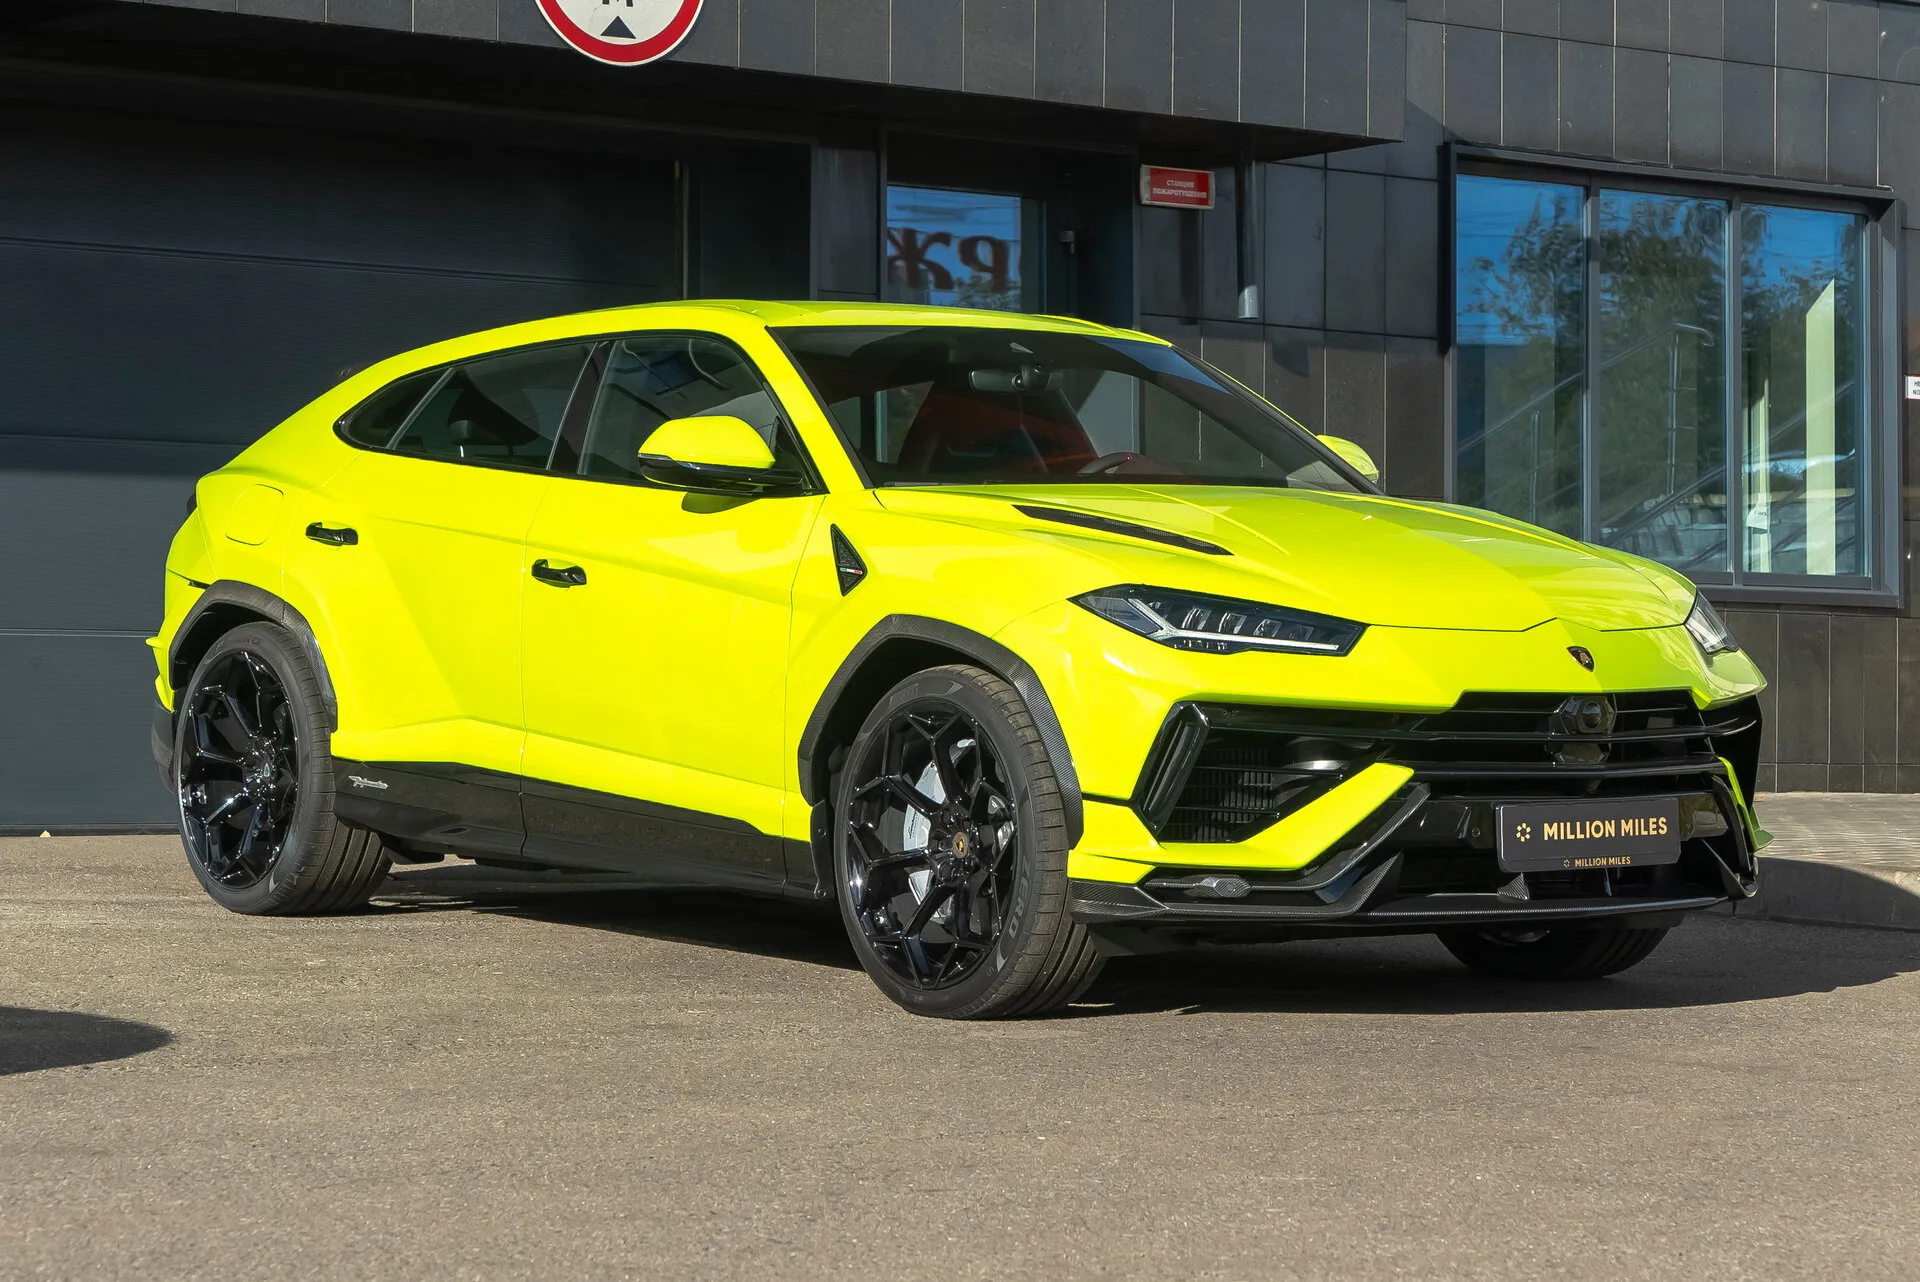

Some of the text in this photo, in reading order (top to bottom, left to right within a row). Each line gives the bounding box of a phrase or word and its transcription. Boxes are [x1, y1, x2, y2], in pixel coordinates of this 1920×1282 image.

[1543, 816, 1668, 841] MILLION MILES
[1574, 856, 1631, 867] MILLION MILES
